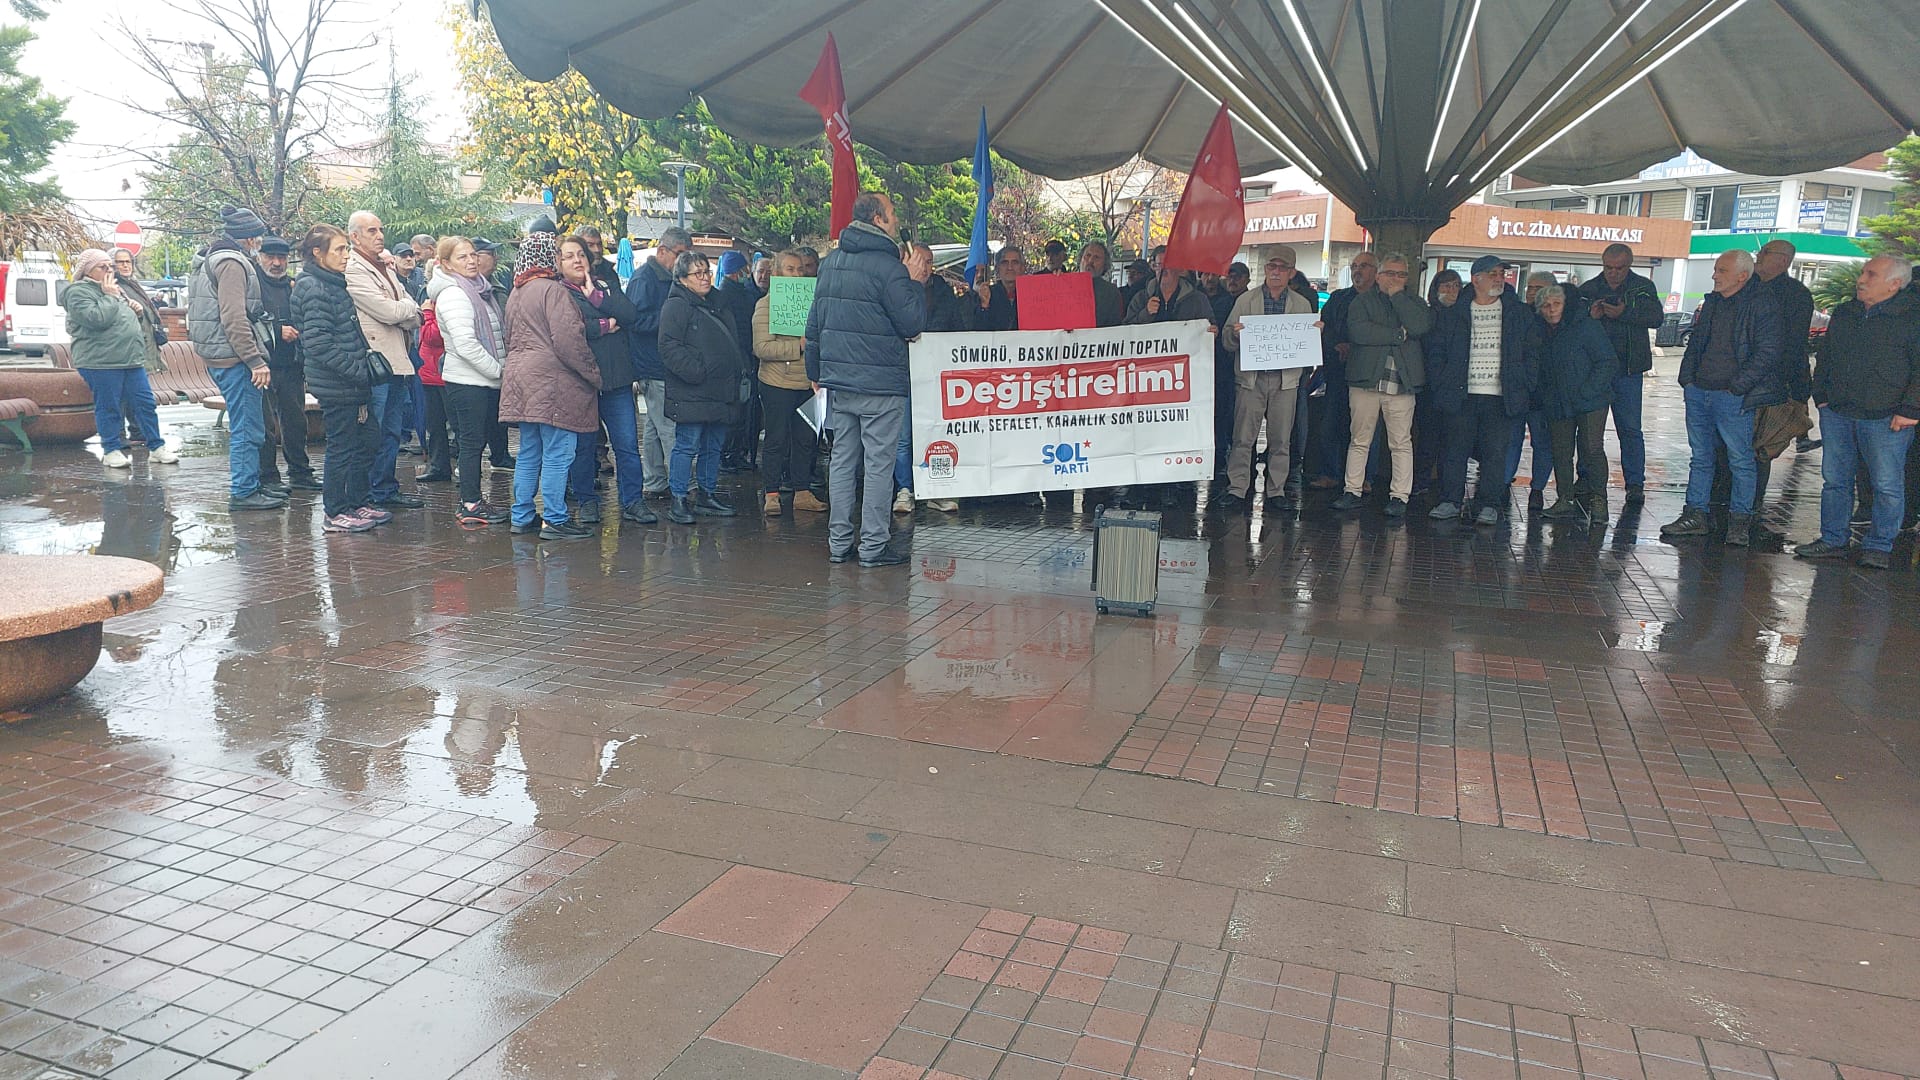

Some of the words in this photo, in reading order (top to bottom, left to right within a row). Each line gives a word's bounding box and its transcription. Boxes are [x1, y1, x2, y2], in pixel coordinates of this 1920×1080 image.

[1245, 217, 1261, 233] AT
[1262, 213, 1318, 231] BANKASI
[1502, 221, 1526, 236] T.C.
[1528, 220, 1581, 239] ZİRAAT
[1581, 226, 1644, 243] BANKASI
[775, 283, 814, 294] EMEKL
[785, 294, 810, 304] MAA
[776, 311, 807, 319] MEMU
[1246, 321, 1315, 334] SERMAYEYE
[952, 345, 1012, 364] SÖMÜRÜ,
[1018, 346, 1059, 362] BASKI
[1062, 340, 1125, 360] DÜZENİNİ
[1130, 338, 1179, 355] TOPTAN
[946, 362, 1185, 409] Değiştirelim!
[946, 419, 985, 437] AÇLIK,
[988, 417, 1043, 432] SEFALET,
[1046, 413, 1107, 429] KARANLIK
[1111, 411, 1134, 425] SON
[1137, 408, 1190, 424] BULSUN!
[1041, 442, 1088, 465] SOL
[1054, 462, 1089, 475] PARTİ
